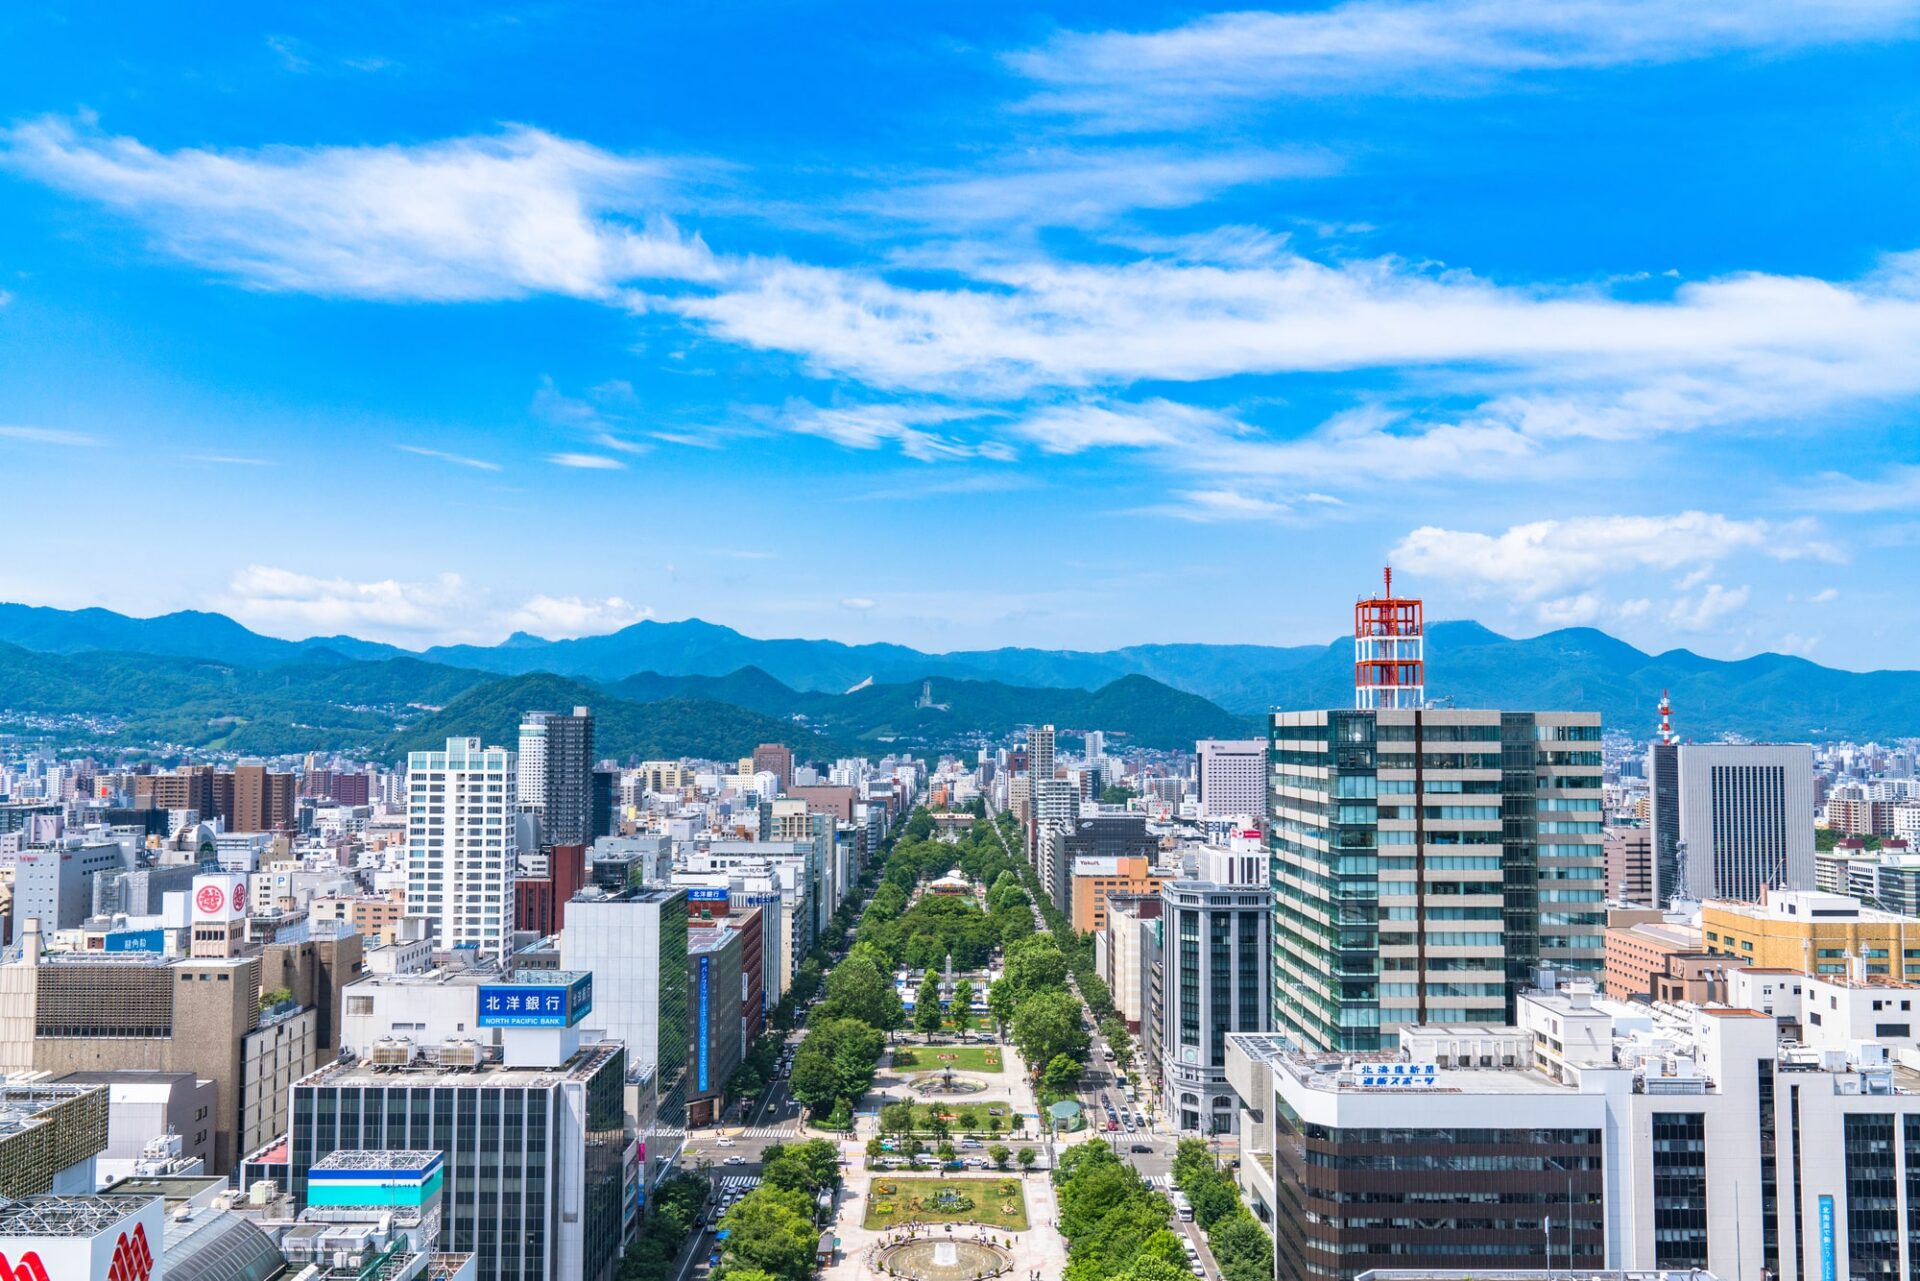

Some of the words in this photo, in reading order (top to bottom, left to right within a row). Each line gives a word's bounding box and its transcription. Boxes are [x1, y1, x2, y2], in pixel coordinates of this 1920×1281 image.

[277, 876, 285, 885] P
[486, 995, 560, 1011] 北洋銀行
[1361, 1065, 1435, 1075] 北海道新聞
